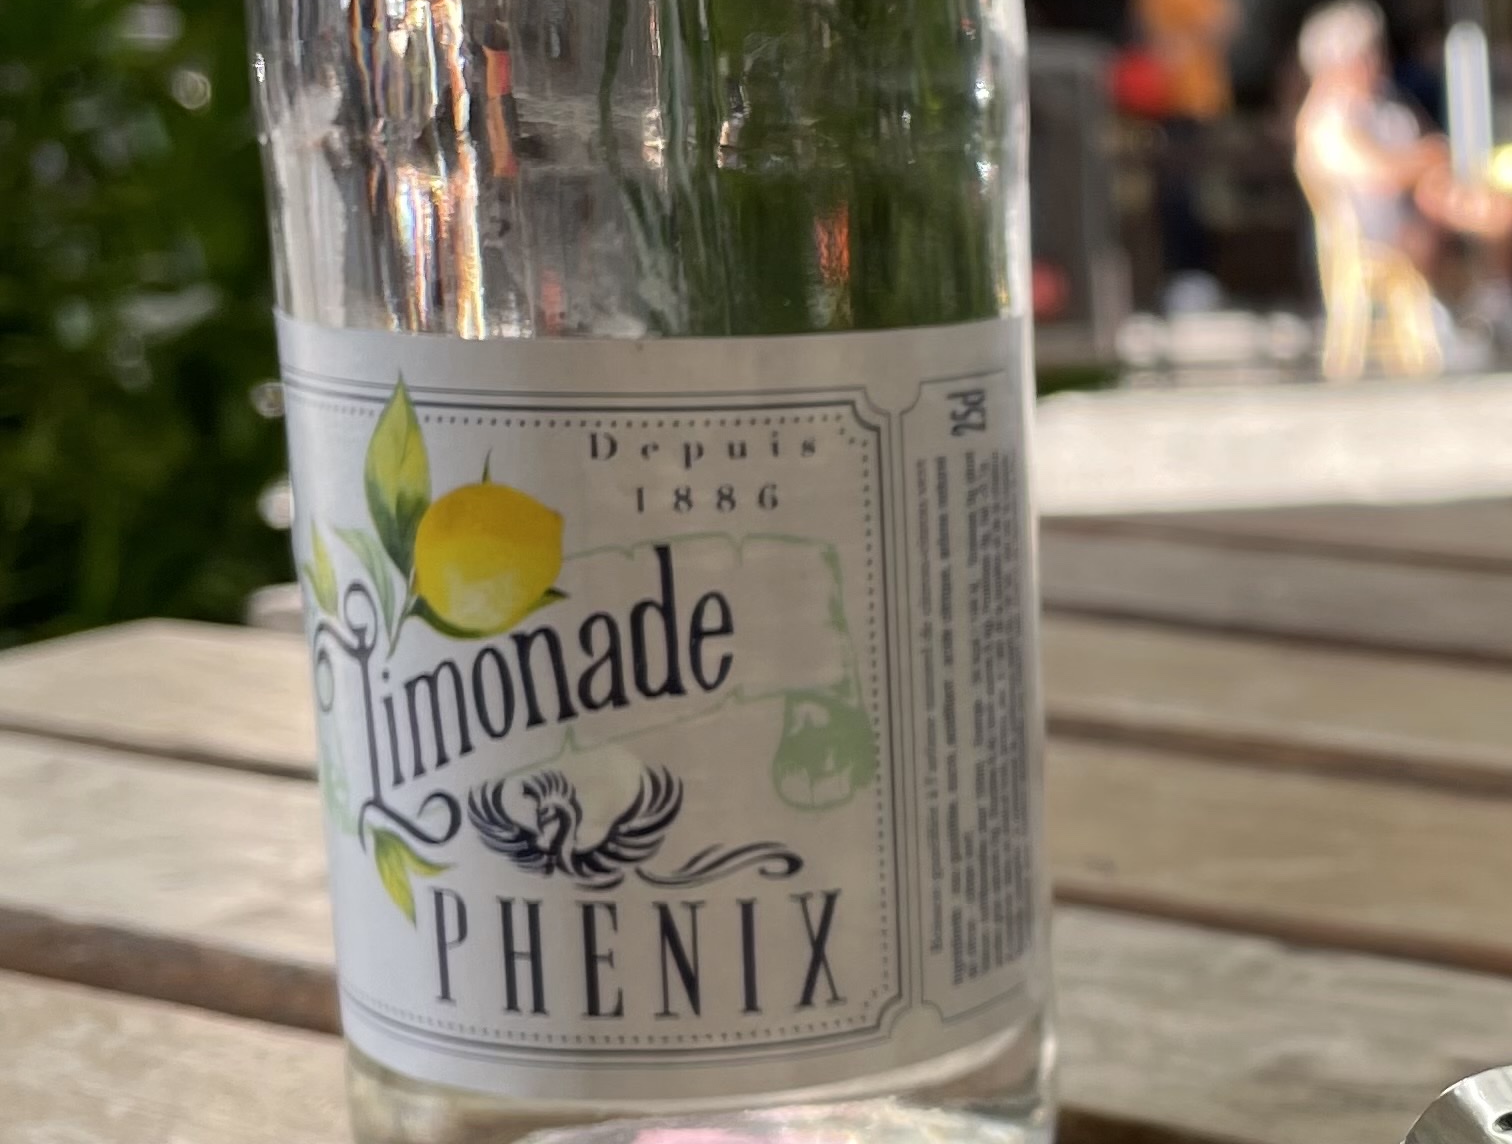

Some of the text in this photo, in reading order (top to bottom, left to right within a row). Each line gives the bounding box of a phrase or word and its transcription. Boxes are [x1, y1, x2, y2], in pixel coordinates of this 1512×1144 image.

[587, 430, 818, 470] Depuis
[634, 483, 780, 513] 1886
[312, 543, 735, 854] Limonade
[428, 885, 848, 1020] PHENIX
